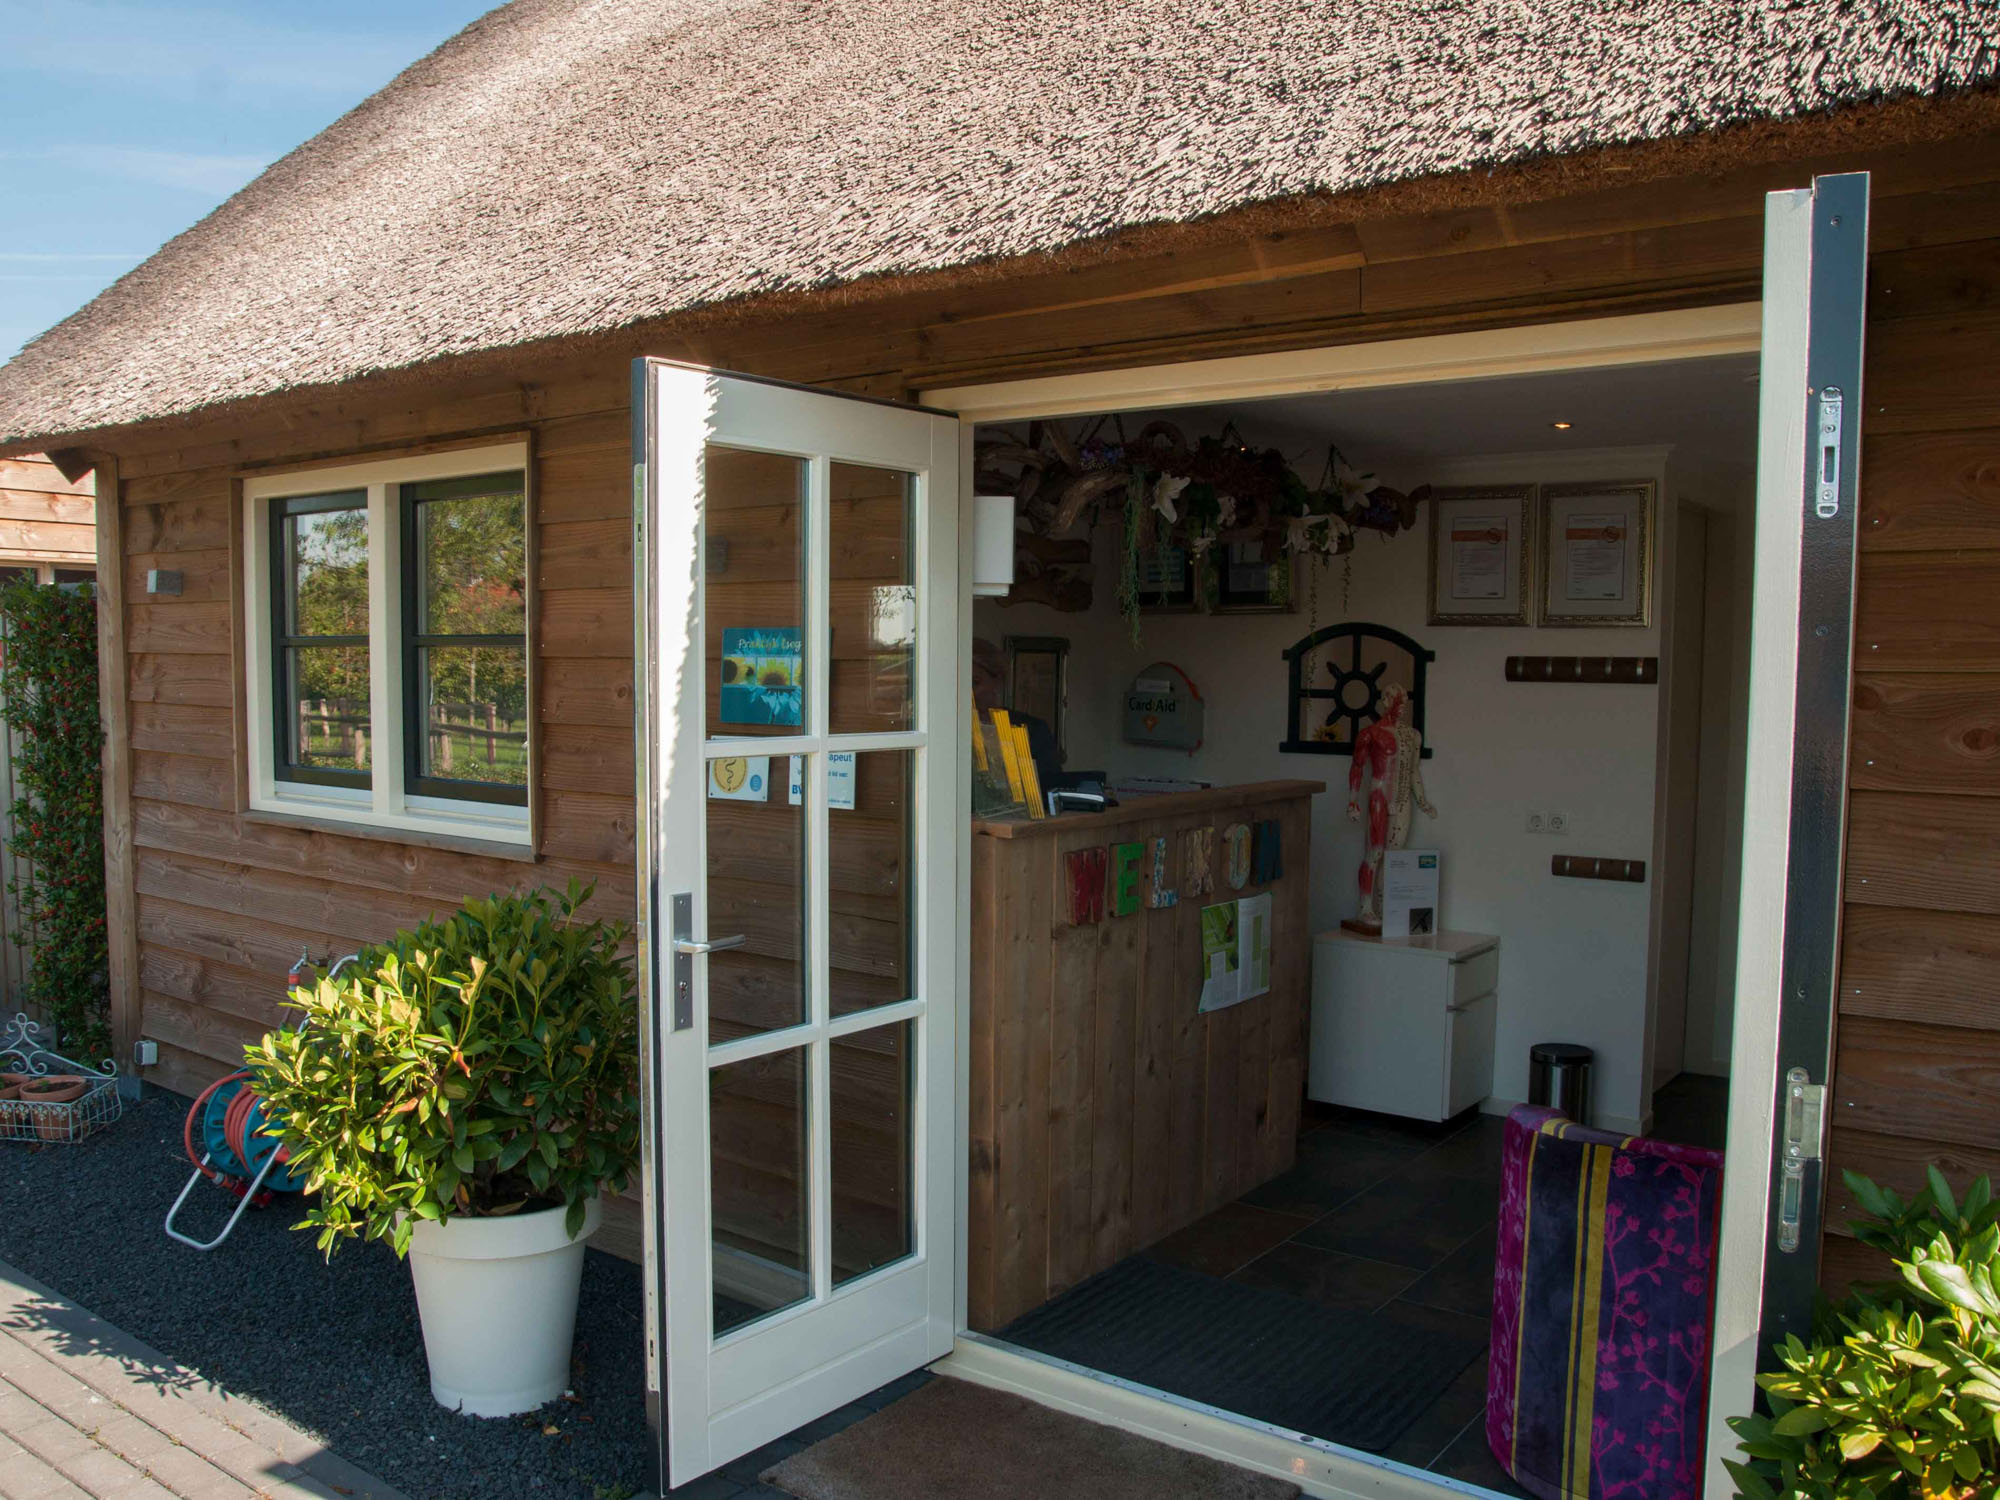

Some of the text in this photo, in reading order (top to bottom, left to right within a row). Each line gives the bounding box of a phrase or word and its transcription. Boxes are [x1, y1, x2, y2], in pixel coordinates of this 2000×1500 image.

[1128, 696, 1176, 713] Card Aid
[1063, 819, 1283, 928] WELKOM
